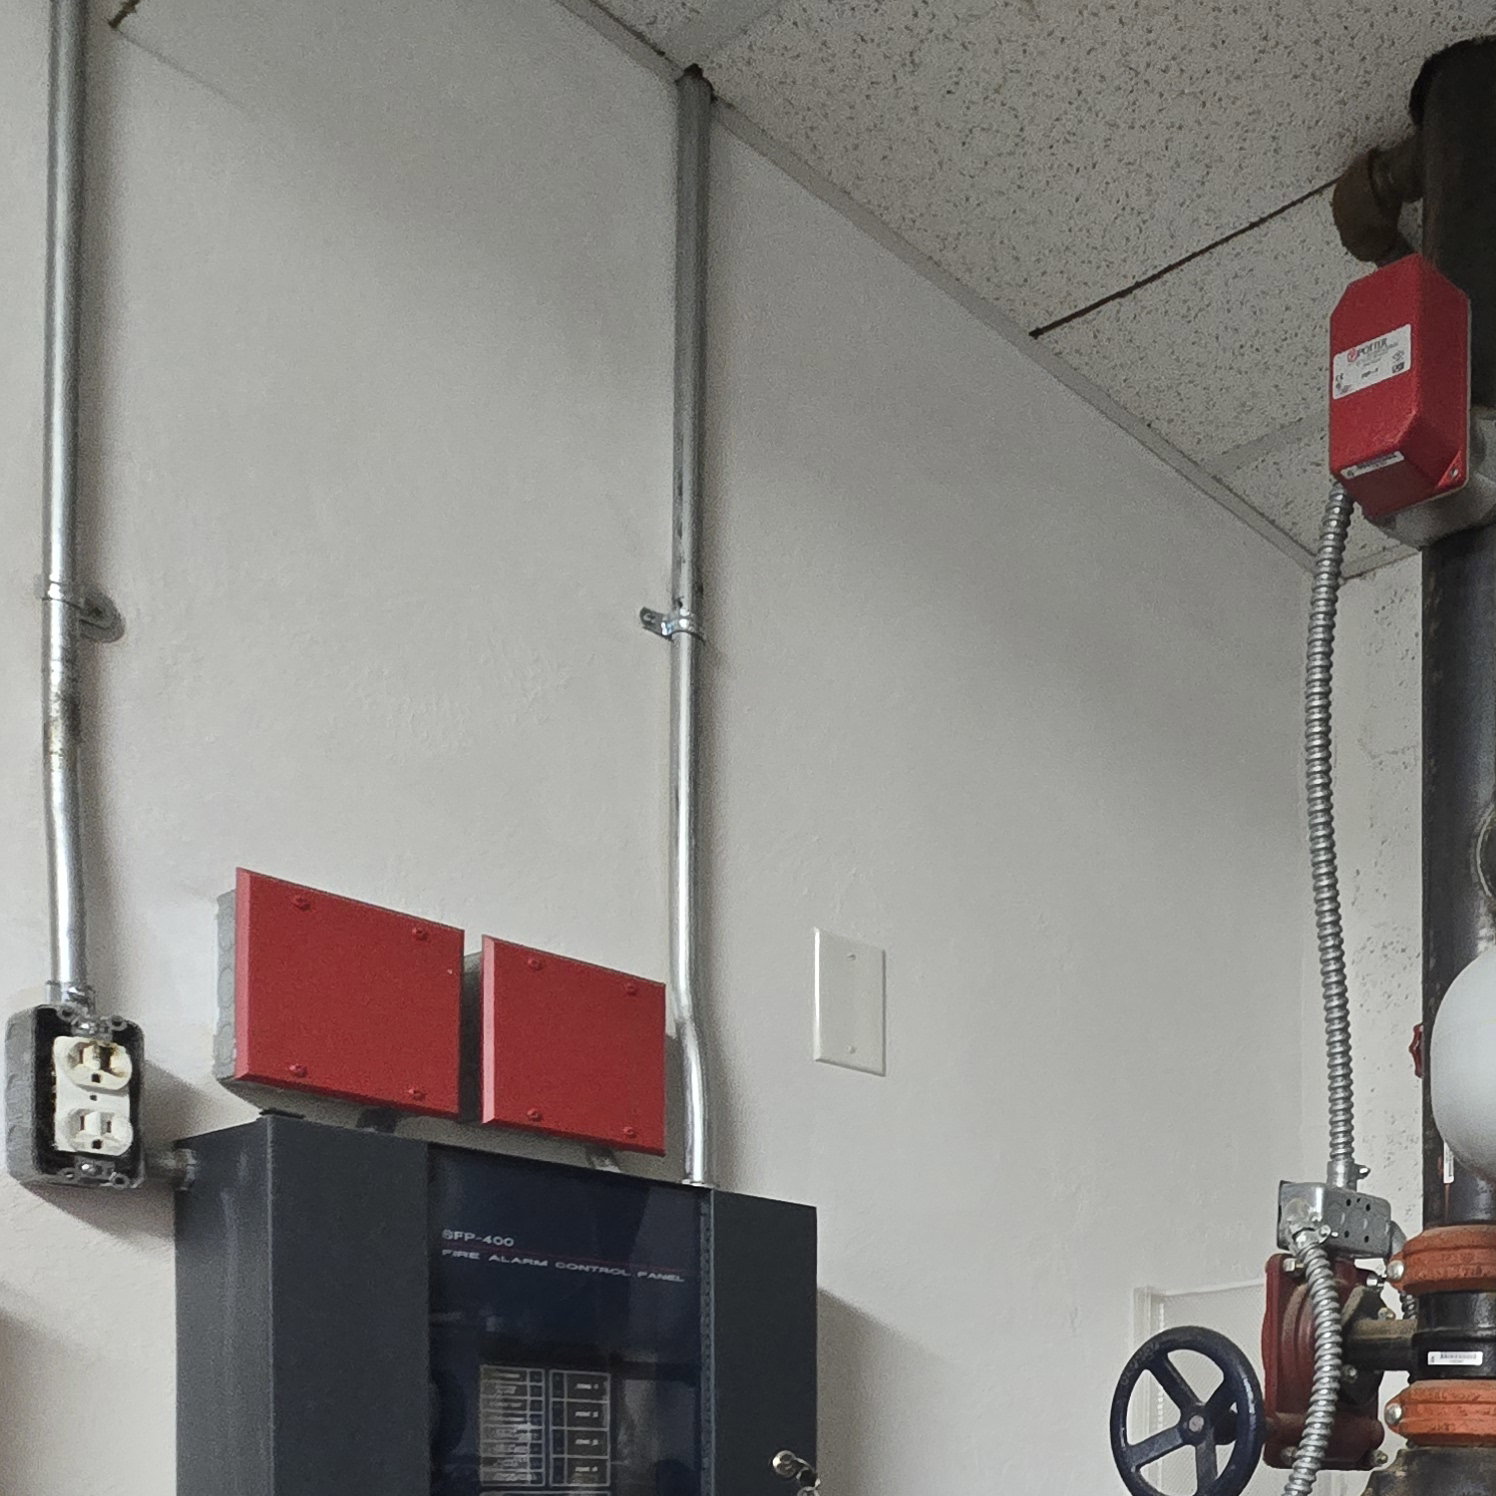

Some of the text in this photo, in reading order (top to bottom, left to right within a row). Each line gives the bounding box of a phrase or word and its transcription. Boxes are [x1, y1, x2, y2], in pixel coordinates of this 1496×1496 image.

[443, 1229, 515, 1248] SFP-400
[442, 1249, 686, 1283] FIRE ALARM CONTROL PANEL
